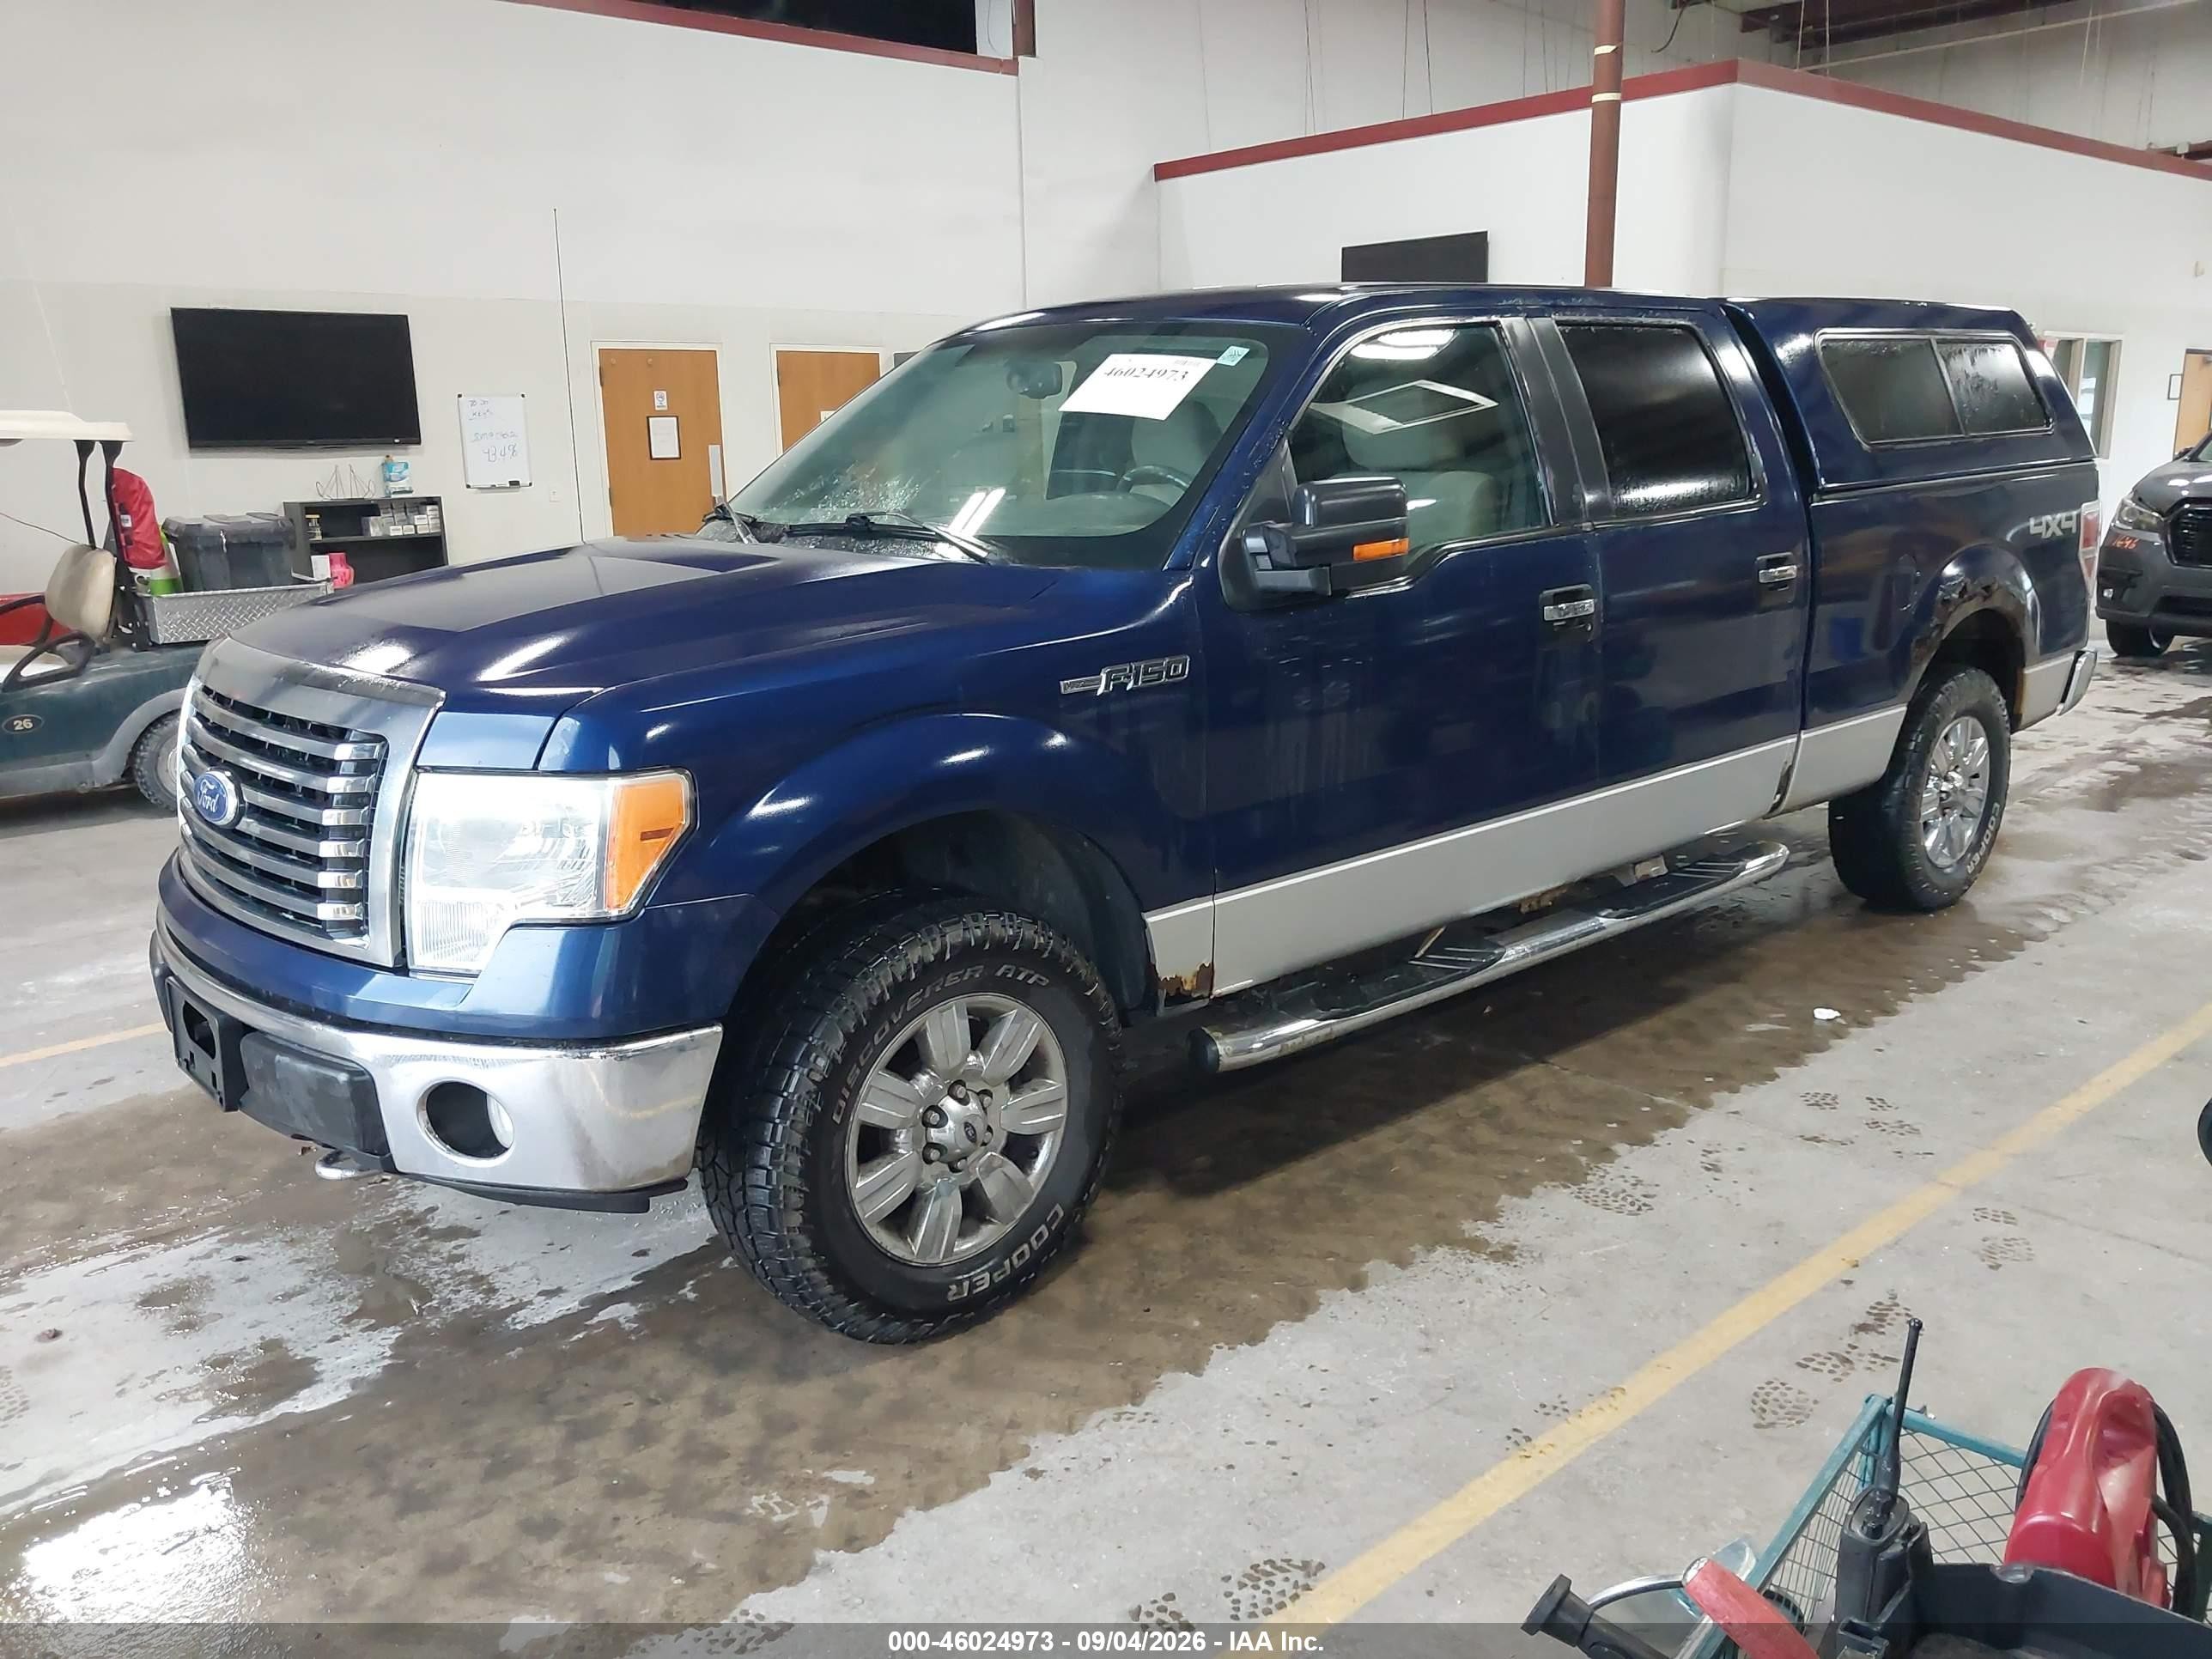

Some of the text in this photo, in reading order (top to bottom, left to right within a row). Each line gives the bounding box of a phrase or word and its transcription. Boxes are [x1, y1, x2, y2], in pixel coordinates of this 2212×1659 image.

[1104, 367, 1189, 382] 46024973
[13, 718, 34, 731] 26
[197, 778, 220, 814] Ford
[1966, 801, 2001, 874] COOPER
[832, 963, 1049, 1126] DISCOVERER ATP
[947, 1203, 1065, 1302] COOPER
